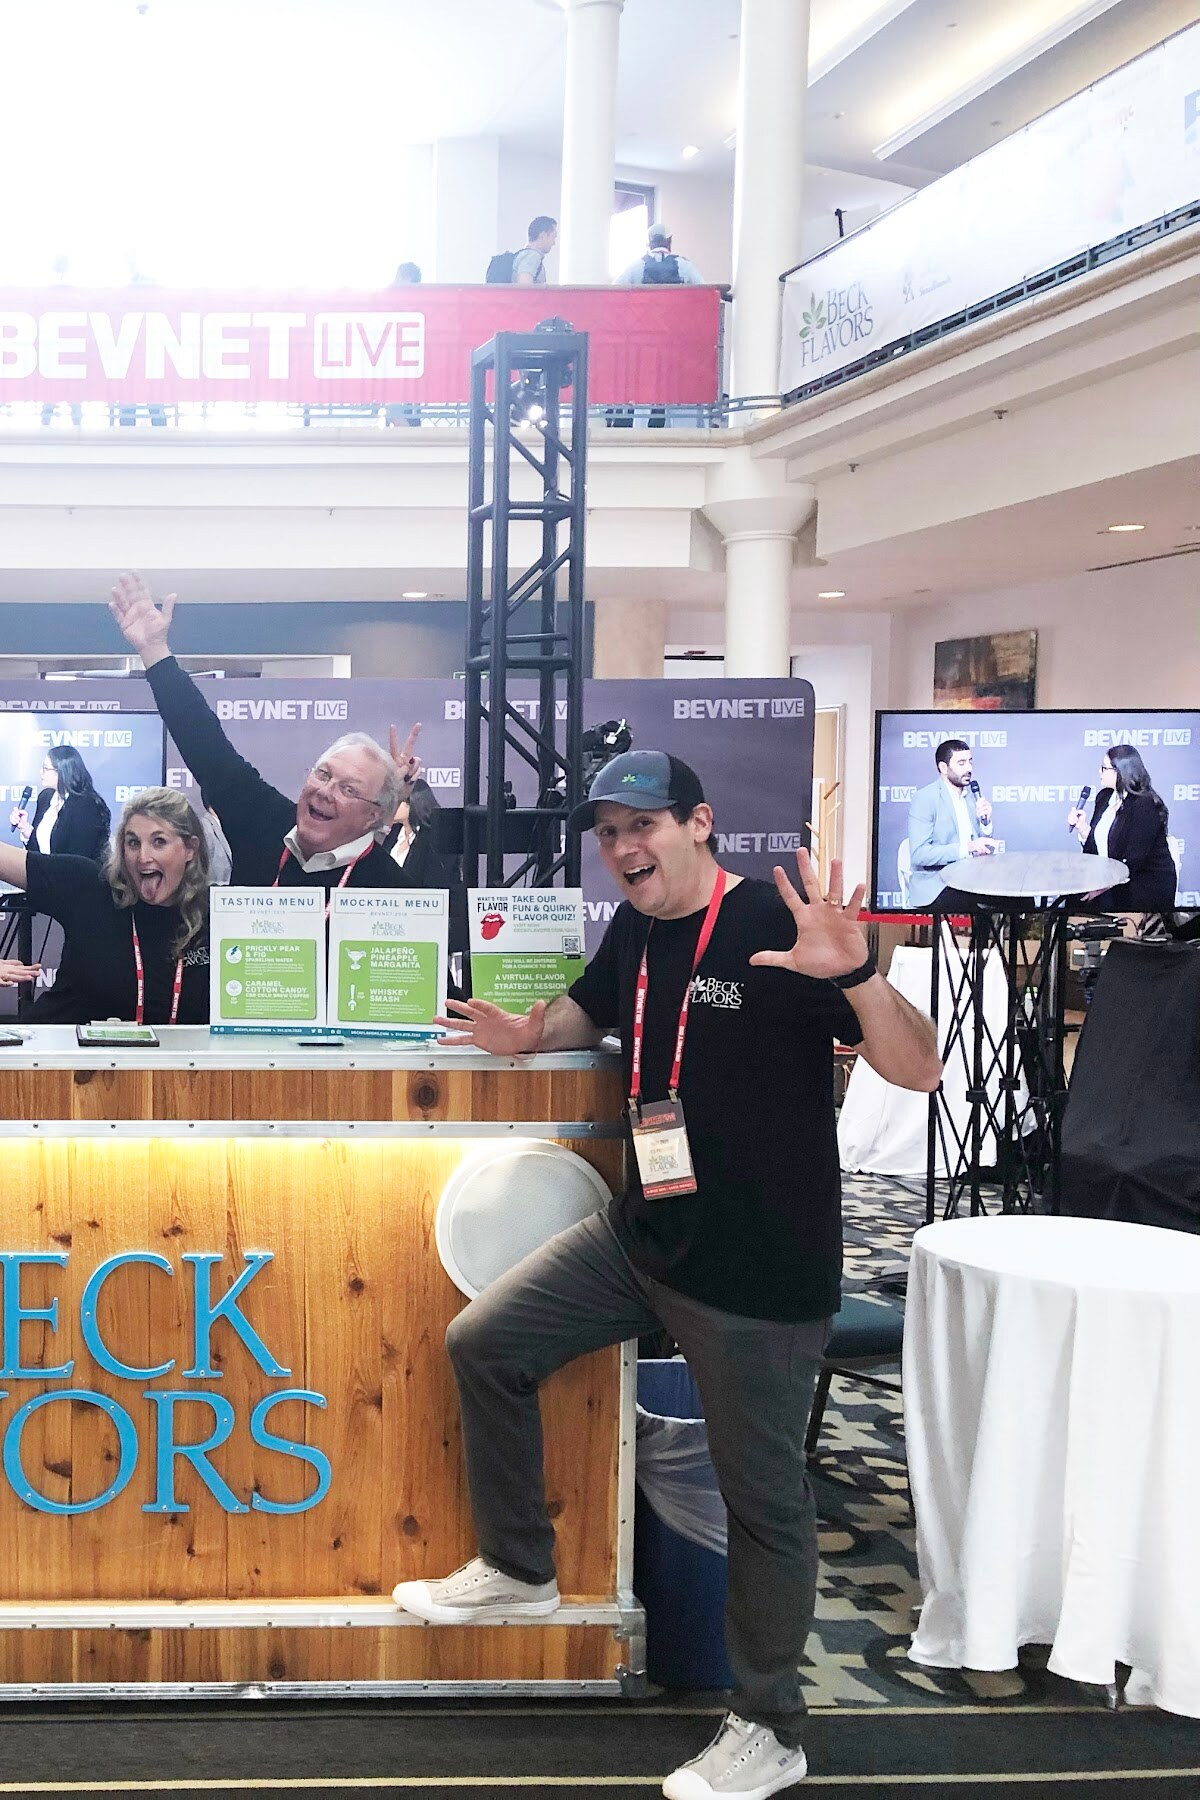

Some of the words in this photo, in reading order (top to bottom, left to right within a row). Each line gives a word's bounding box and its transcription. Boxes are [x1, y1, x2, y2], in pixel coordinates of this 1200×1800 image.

[827, 281, 868, 325] BECK
[802, 306, 873, 368] FLAVORS
[317, 315, 424, 376] LIVE
[216, 700, 312, 720] BEVNET
[315, 702, 347, 718] LIVE
[673, 699, 770, 719] BEVNET
[772, 699, 804, 717] LIVE
[104, 732, 131, 747] LIVE
[981, 731, 1007, 747] LIVE
[1084, 729, 1163, 747] BEVNET
[1164, 730, 1191, 746] LIVE
[428, 769, 460, 786] LIVE
[992, 786, 1067, 802] BEVNET
[768, 833, 800, 852] LIVE
[221, 898, 274, 906] TASTING
[280, 898, 315, 906] MENU
[340, 899, 400, 907] MOCKTAIL
[405, 900, 439, 908] MENU
[477, 903, 509, 913] FLAVOR
[543, 905, 577, 913] QUIRKY
[371, 947, 415, 955] JALAPEÑO
[371, 961, 421, 969] MARGARITA
[706, 978, 740, 994] BECK
